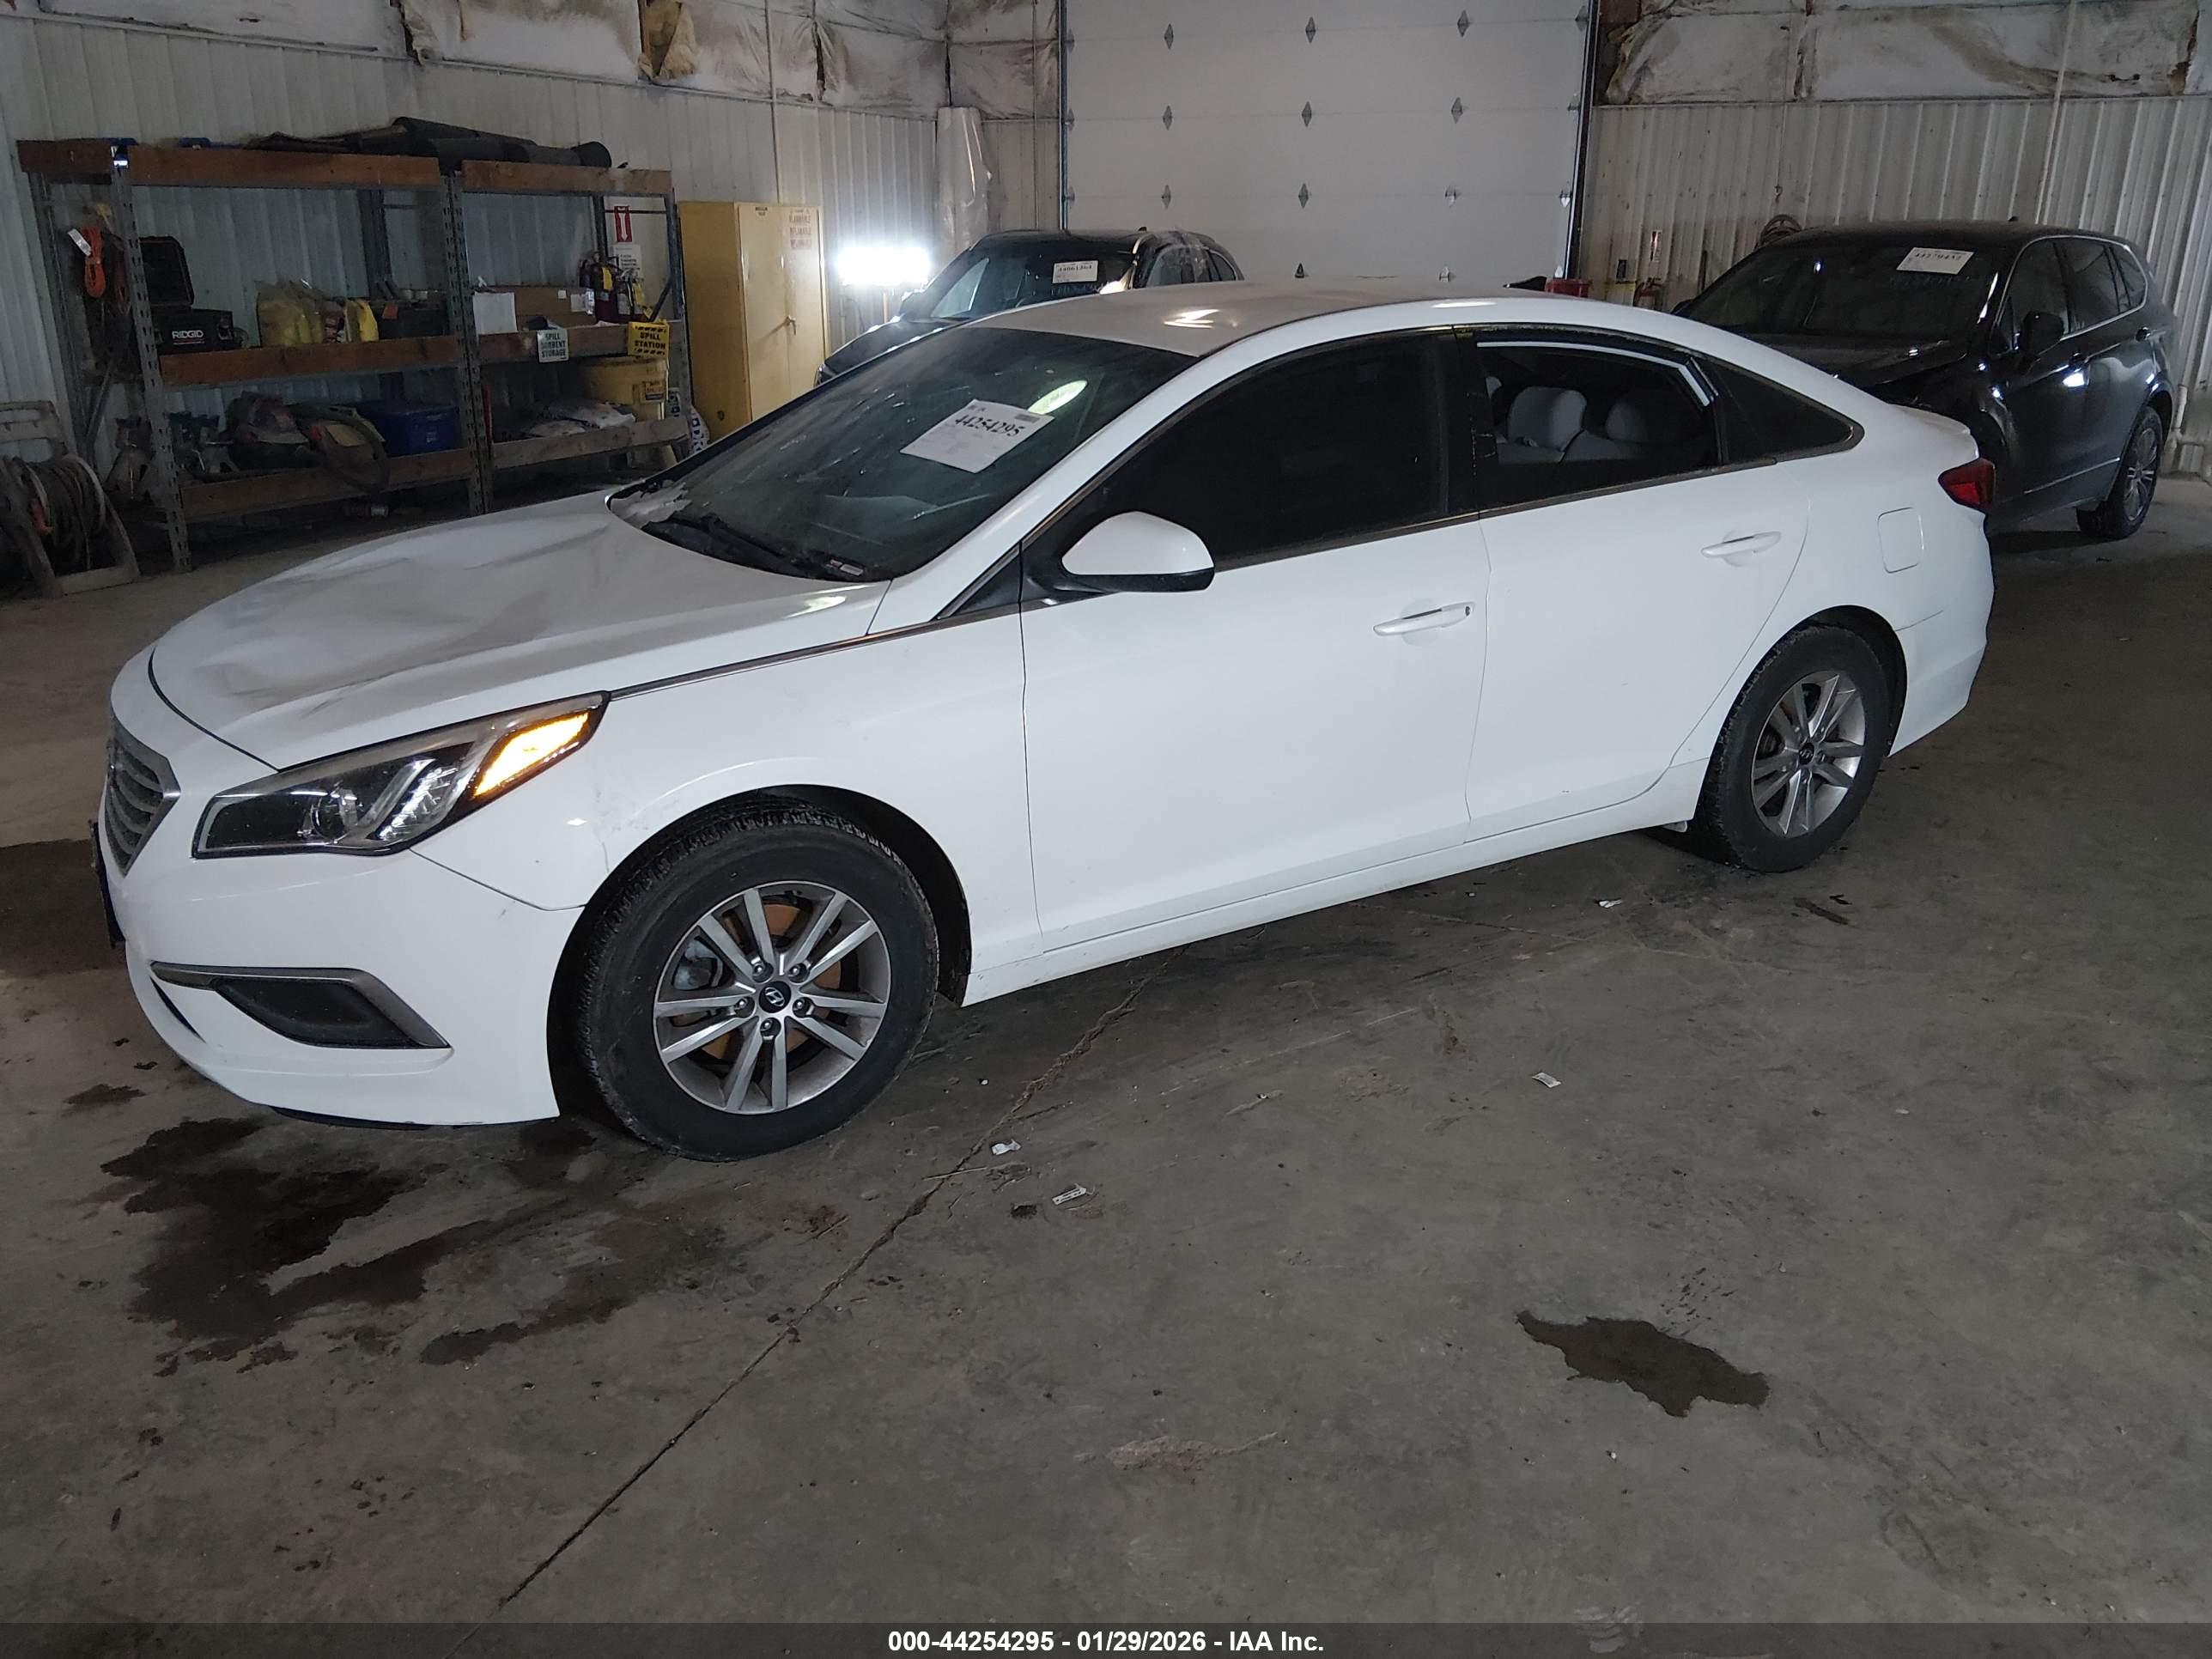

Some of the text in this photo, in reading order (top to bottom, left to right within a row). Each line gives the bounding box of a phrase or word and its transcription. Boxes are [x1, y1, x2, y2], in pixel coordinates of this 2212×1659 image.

[172, 330, 204, 339] RIDGID
[640, 331, 660, 340] SPILL
[635, 340, 665, 350] STATION
[542, 349, 566, 358] STORAGE
[955, 415, 1025, 436] 44254295
